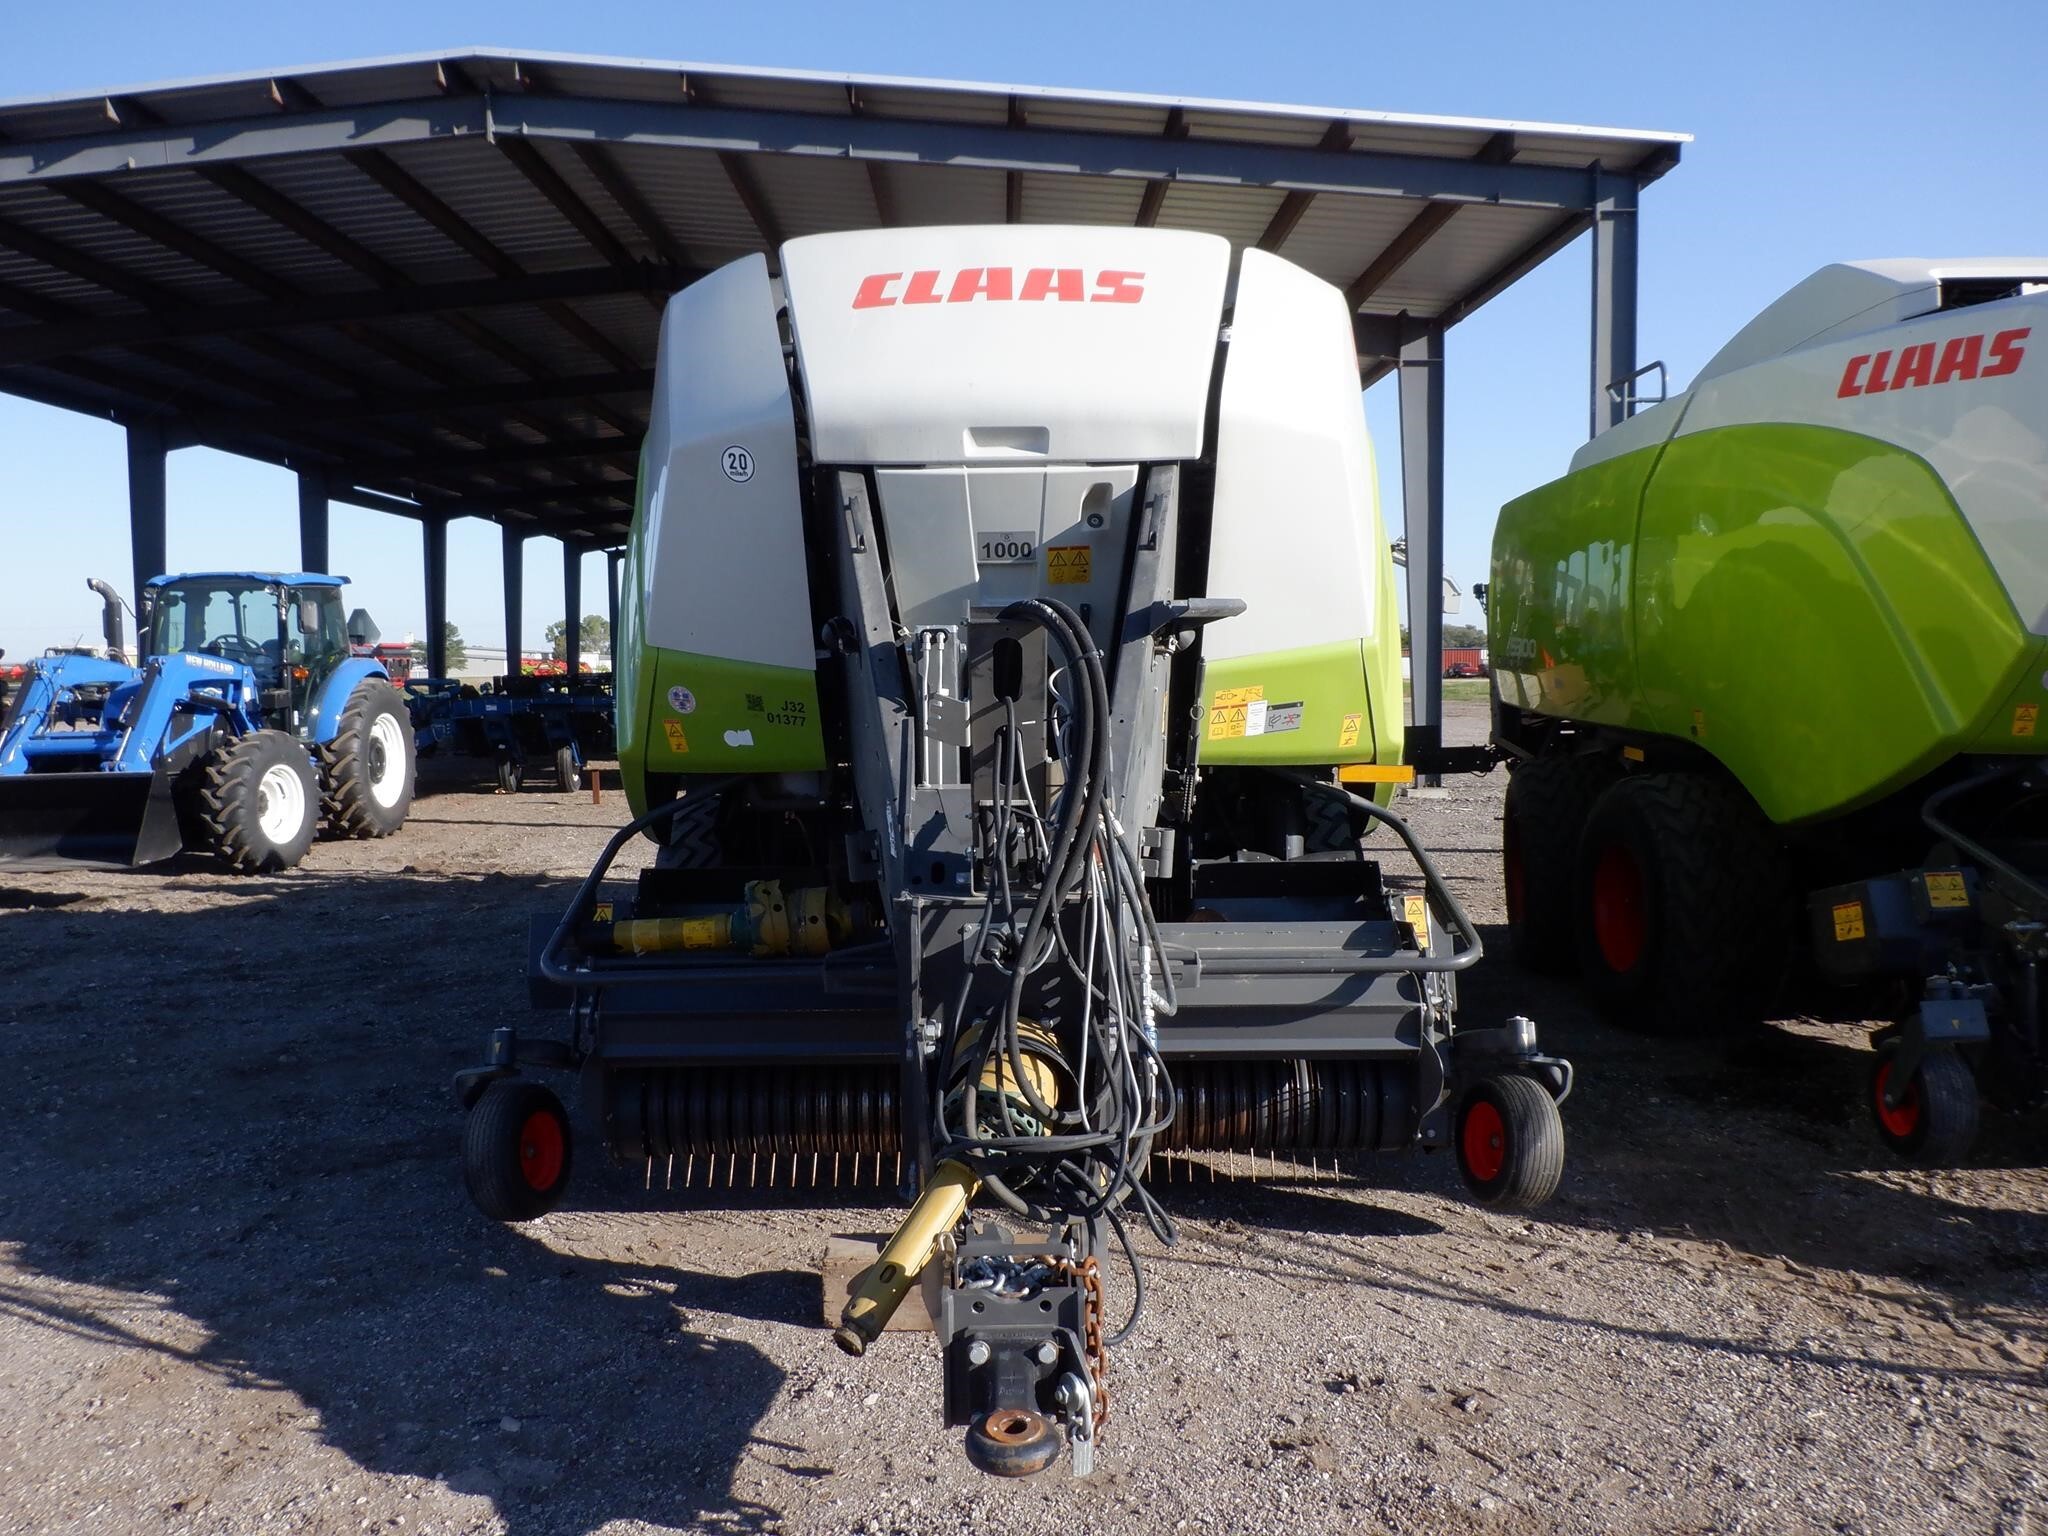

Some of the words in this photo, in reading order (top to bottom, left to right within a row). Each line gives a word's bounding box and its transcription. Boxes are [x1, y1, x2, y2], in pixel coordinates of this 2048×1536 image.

[852, 267, 1145, 309] CLAAS
[1837, 327, 2032, 398] CLAAS
[728, 452, 748, 470] 20
[982, 542, 1032, 559] 1000
[185, 654, 203, 667] NEW
[203, 658, 234, 675] HOLLAND
[781, 700, 806, 713] J32
[767, 712, 806, 727] 01377
